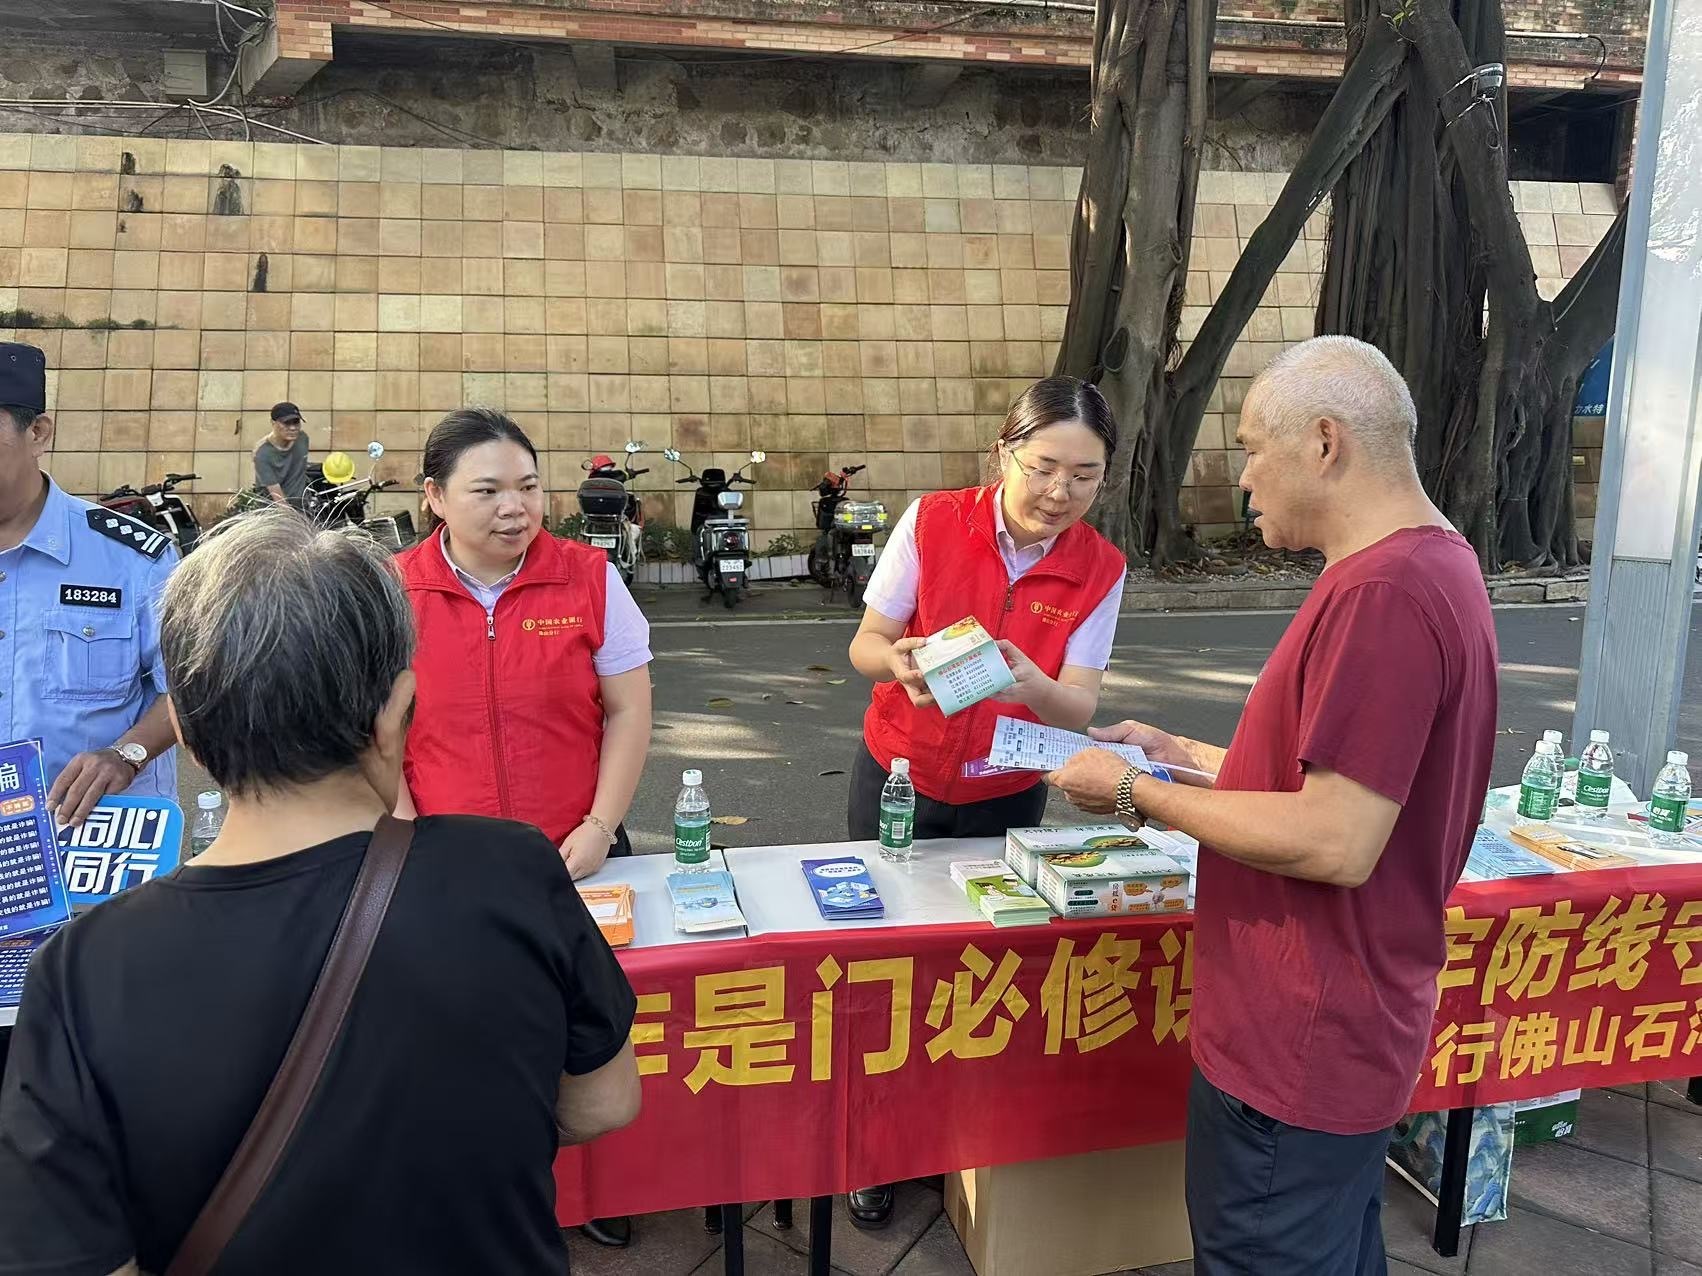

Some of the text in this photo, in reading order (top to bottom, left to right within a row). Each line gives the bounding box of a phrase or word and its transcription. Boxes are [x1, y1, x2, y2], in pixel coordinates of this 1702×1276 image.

[65, 589, 117, 603] 183284
[0, 853, 42, 868] 的就是诈骗!
[61, 851, 160, 895] 同行
[1416, 998, 1702, 1087] 行佛山石
